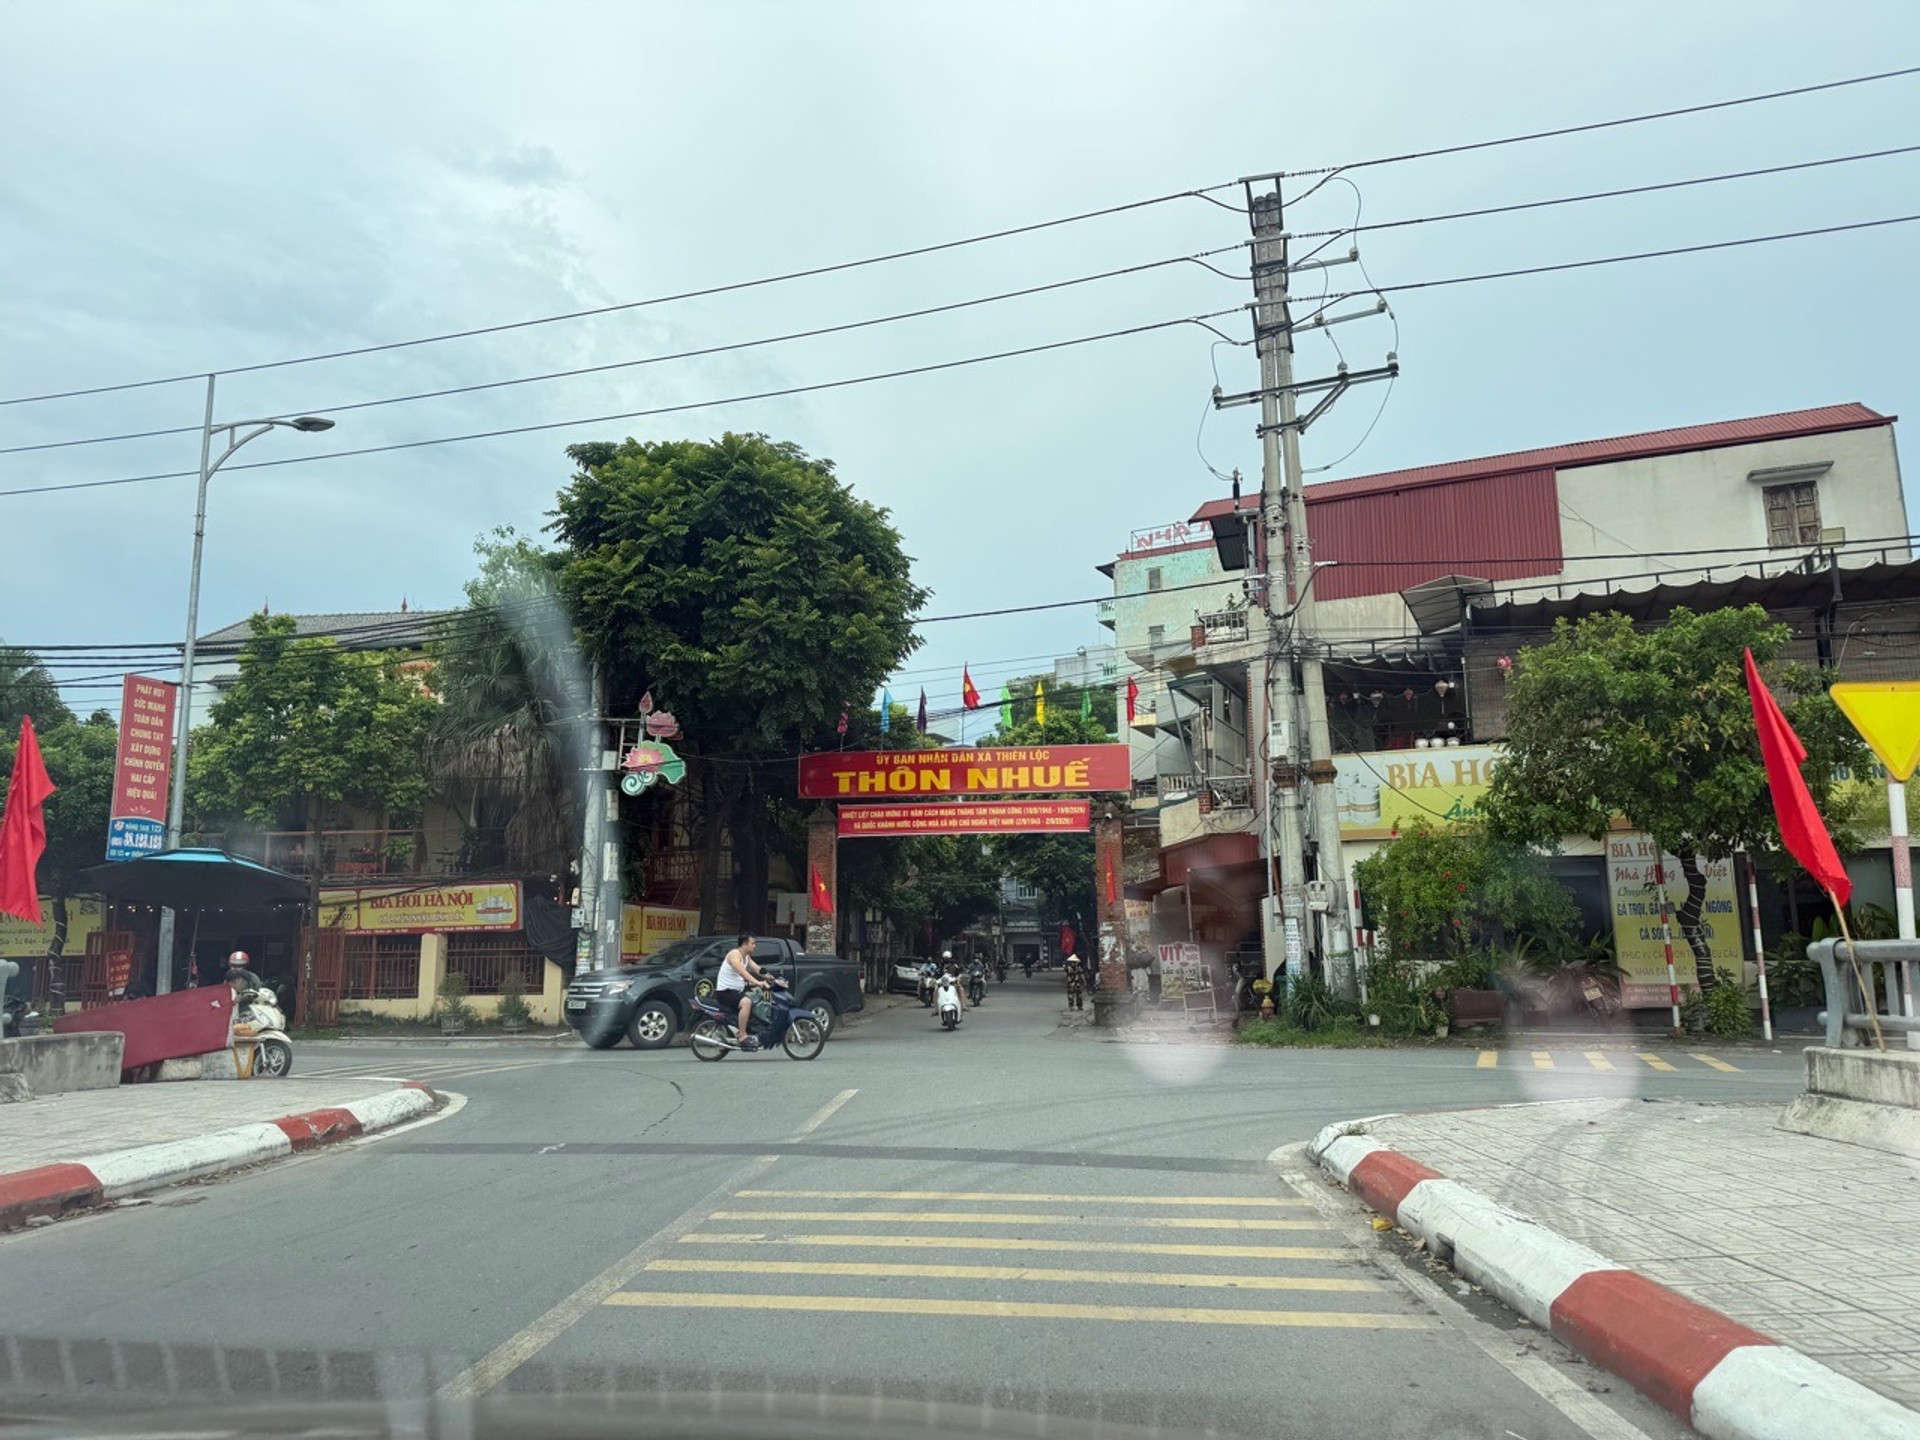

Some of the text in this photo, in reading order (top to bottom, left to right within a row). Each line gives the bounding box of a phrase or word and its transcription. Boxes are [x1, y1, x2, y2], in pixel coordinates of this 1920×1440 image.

[1137, 521, 1191, 549] NHÀ
[136, 684, 165, 698] PHÁT HUY
[133, 697, 166, 713] SỨC MẠNH
[133, 713, 164, 727] TOÀN DÂN
[130, 728, 164, 742] CHUNG TAY
[130, 742, 161, 757] XÂY DỰNG
[876, 751, 890, 765] ỦY
[893, 753, 916, 765] BAN
[918, 751, 948, 764] NHÂN
[978, 750, 992, 763] XÃ
[995, 749, 1026, 762] THIÊN
[1029, 748, 1050, 762] LỘC
[124, 757, 165, 771] CHÍNH QUYỀN
[130, 773, 156, 784] HAI CẤP
[832, 757, 1091, 793] THÔN NHUẾ
[1385, 761, 1441, 790] BIA
[126, 787, 142, 799] HIỆU
[841, 811, 858, 819] NHIỆT
[858, 811, 870, 819] LIỆT
[870, 810, 884, 818] CHÀO
[885, 809, 901, 818] MỪNG
[910, 809, 923, 817] NĂM
[939, 808, 956, 816] MẠNG
[957, 808, 975, 816] THÁNG
[975, 807, 988, 815] TÁM
[988, 807, 1006, 815] THÀNH
[1007, 806, 1022, 814] CÔNG
[151, 824, 162, 832] 123
[862, 821, 876, 829] QUỐC
[877, 820, 895, 828] KHÁNH
[896, 820, 911, 828] NƯỚC
[912, 820, 927, 828] CỘNG
[940, 819, 948, 827] XÃ
[948, 819, 958, 827] HỘI
[959, 818, 970, 826] CHỦ
[970, 818, 988, 826] NGHĨA
[988, 818, 1000, 827] VIỆT
[1611, 842, 1633, 857] BIA
[1615, 864, 1727, 883] Nhà Hg Việt
[370, 889, 474, 909] BIA HƠI HÀ NỘI
[1617, 899, 1628, 916] GÀ
[646, 915, 657, 930] BIA
[1160, 946, 1181, 965] VỊT
